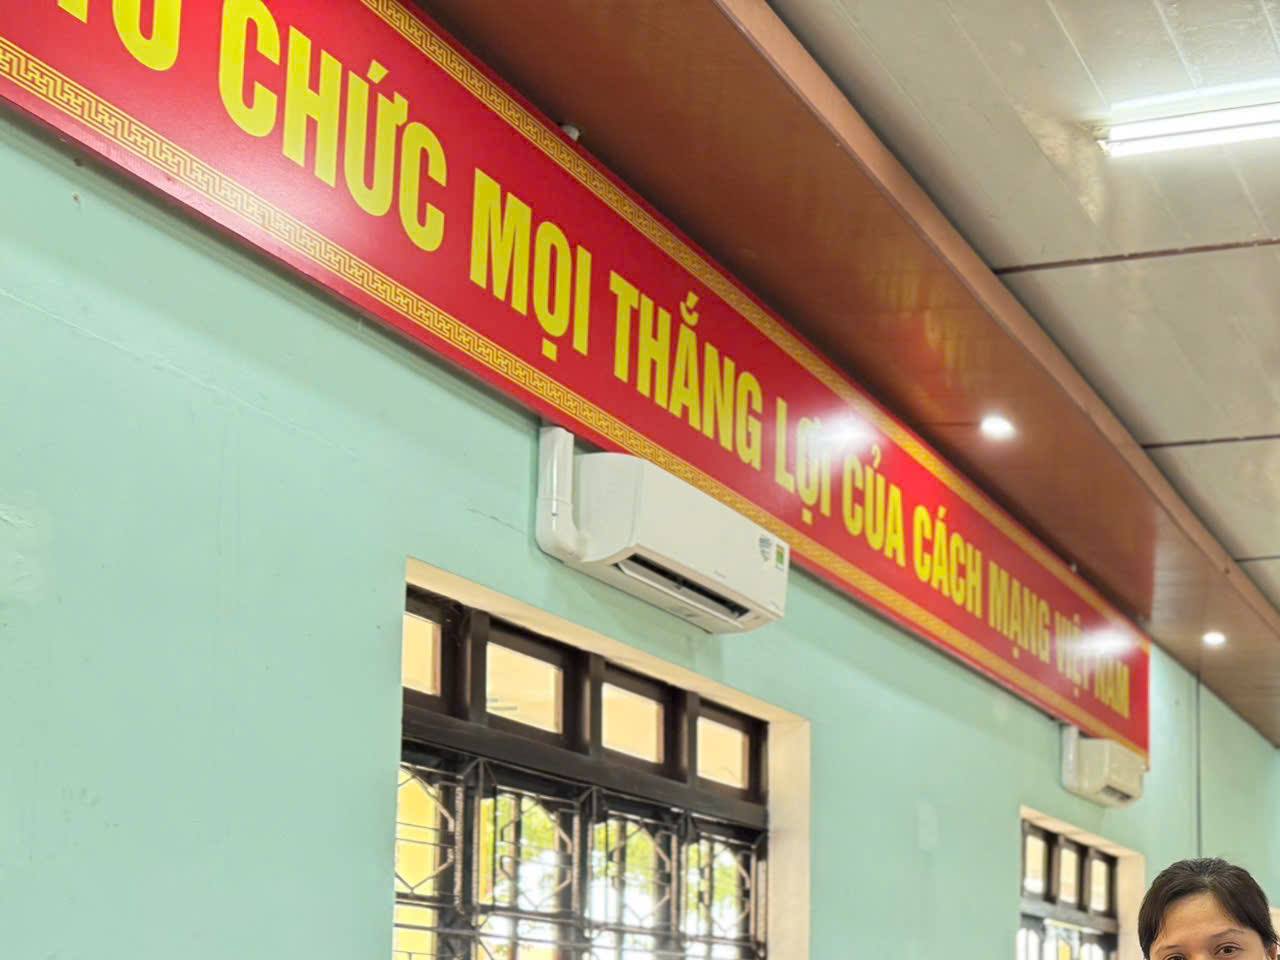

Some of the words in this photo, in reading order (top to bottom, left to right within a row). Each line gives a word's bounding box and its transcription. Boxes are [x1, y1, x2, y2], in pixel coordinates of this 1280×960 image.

[220, 0, 447, 251] CHỨC
[470, 167, 592, 362] MỌI
[609, 270, 763, 472] THẮNG
[842, 443, 906, 567] CỦA
[913, 505, 982, 619] CÁCH
[988, 560, 1050, 664] MẠNG
